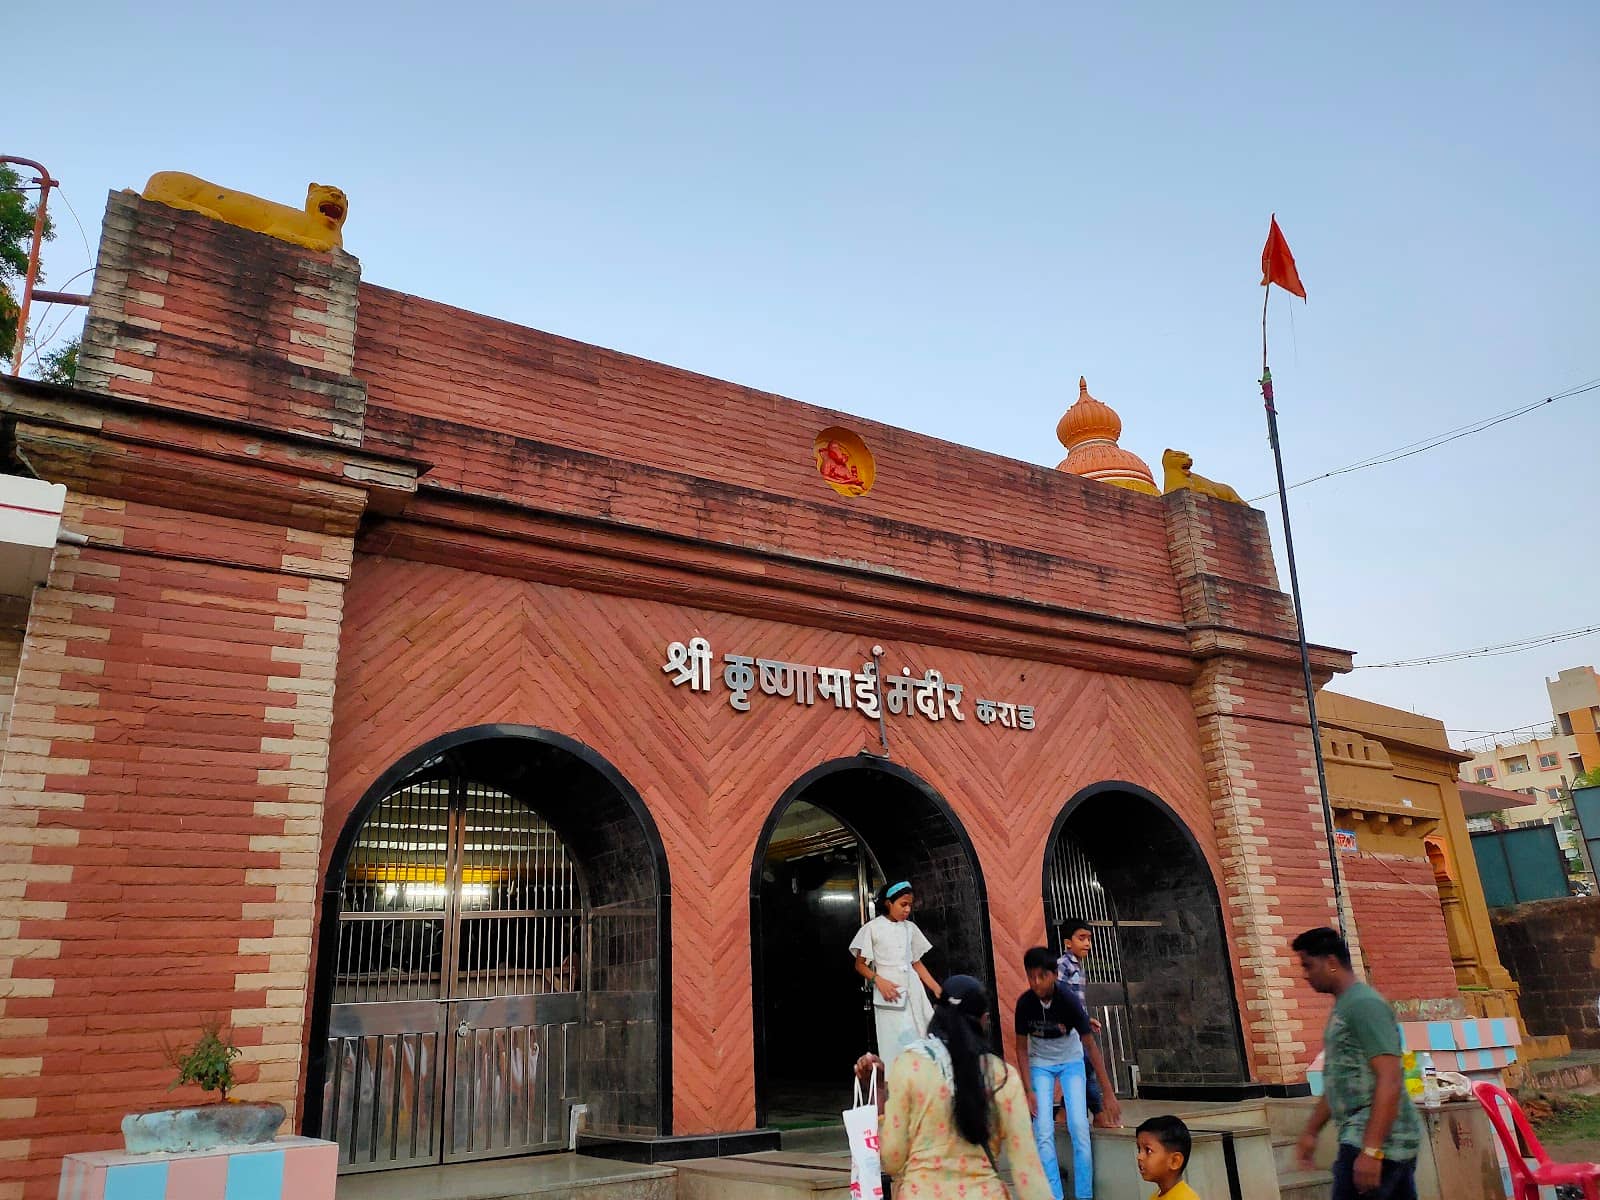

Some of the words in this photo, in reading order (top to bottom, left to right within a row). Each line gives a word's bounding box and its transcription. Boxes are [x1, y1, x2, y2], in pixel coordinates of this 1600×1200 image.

[662, 637, 713, 691] श्री
[886, 666, 965, 721] मंदीर
[976, 698, 1036, 730] कराड
